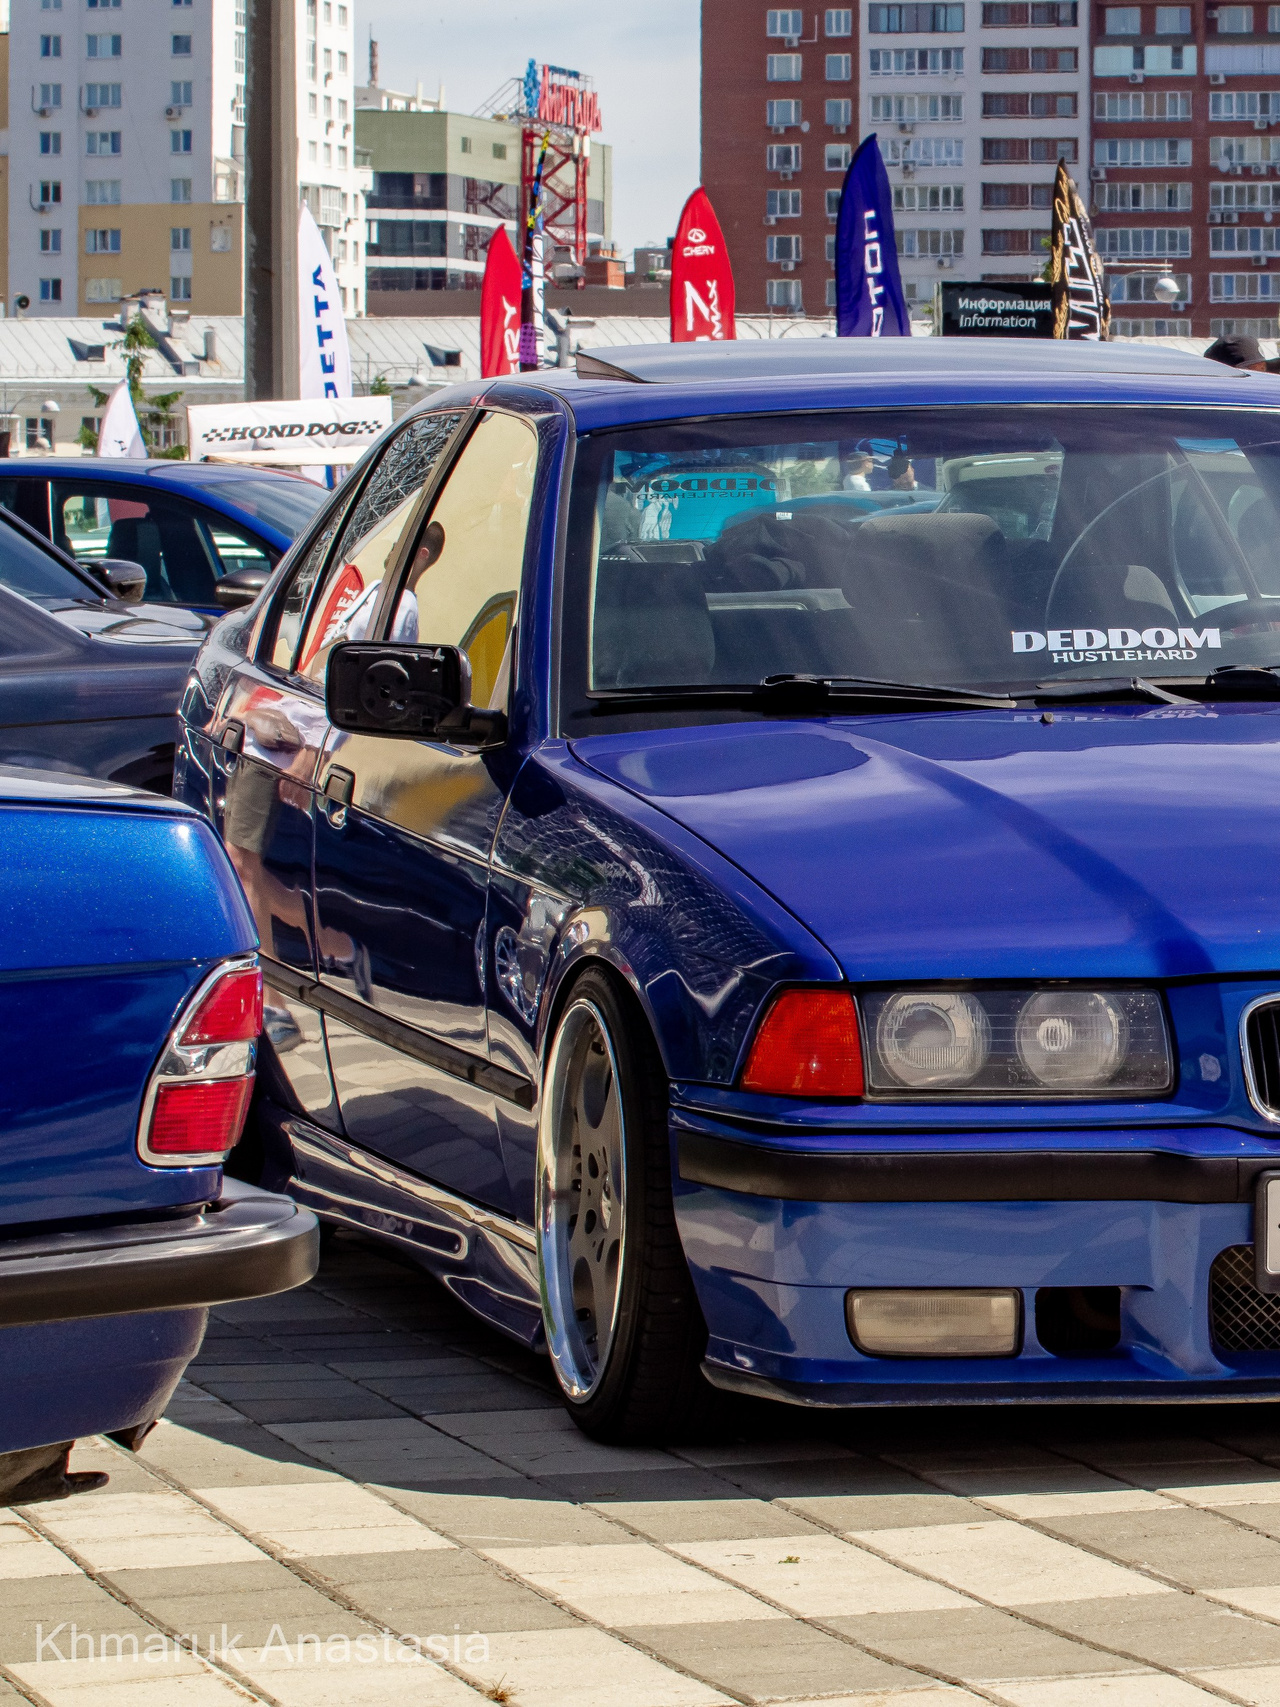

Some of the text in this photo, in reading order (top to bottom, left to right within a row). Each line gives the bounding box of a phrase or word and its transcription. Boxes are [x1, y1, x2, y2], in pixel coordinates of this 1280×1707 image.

[682, 245, 715, 257] CHERY
[958, 297, 1051, 314] Информация
[959, 315, 1037, 329] Information
[226, 421, 360, 441] HOND DOG
[1012, 627, 1222, 653] DEDDOM
[1052, 650, 1198, 663] HUSTLEHARD
